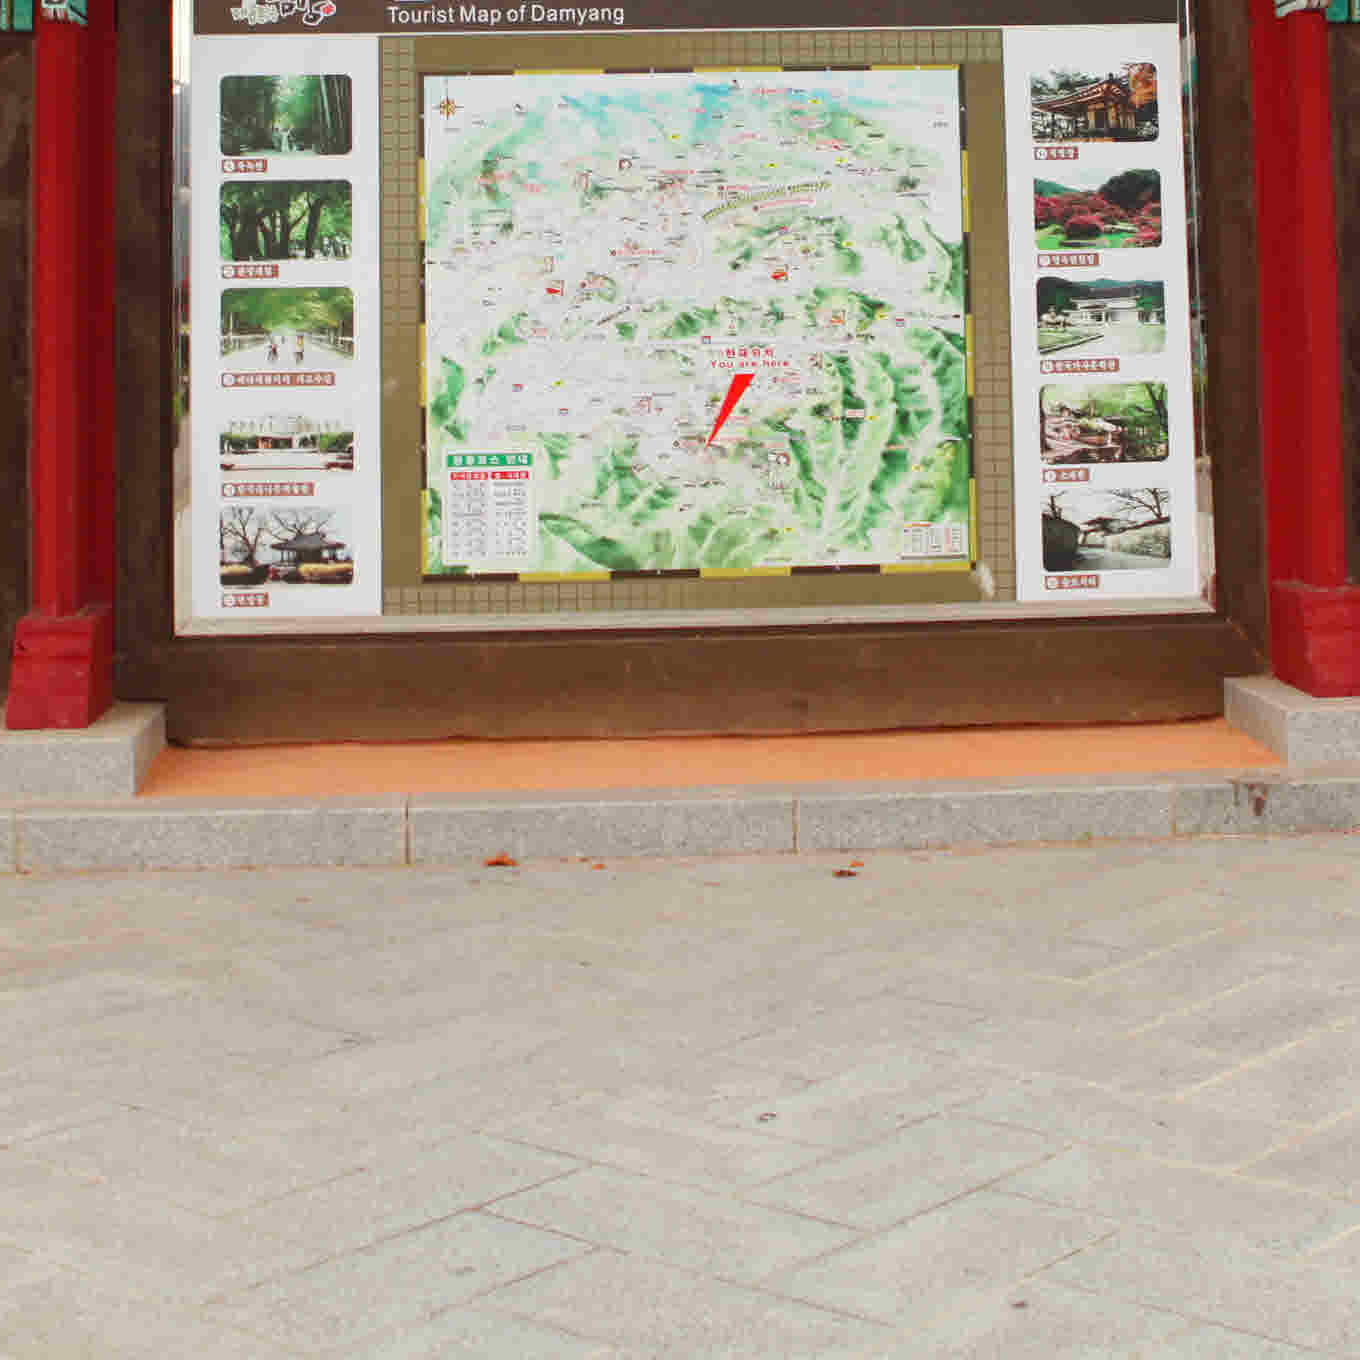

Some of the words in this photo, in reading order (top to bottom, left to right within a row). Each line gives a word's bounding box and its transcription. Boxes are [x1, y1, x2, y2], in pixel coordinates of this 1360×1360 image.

[387, 6, 454, 24] Tourist
[459, 6, 501, 26] Map
[506, 4, 527, 22] of
[531, 4, 625, 26] Damyang
